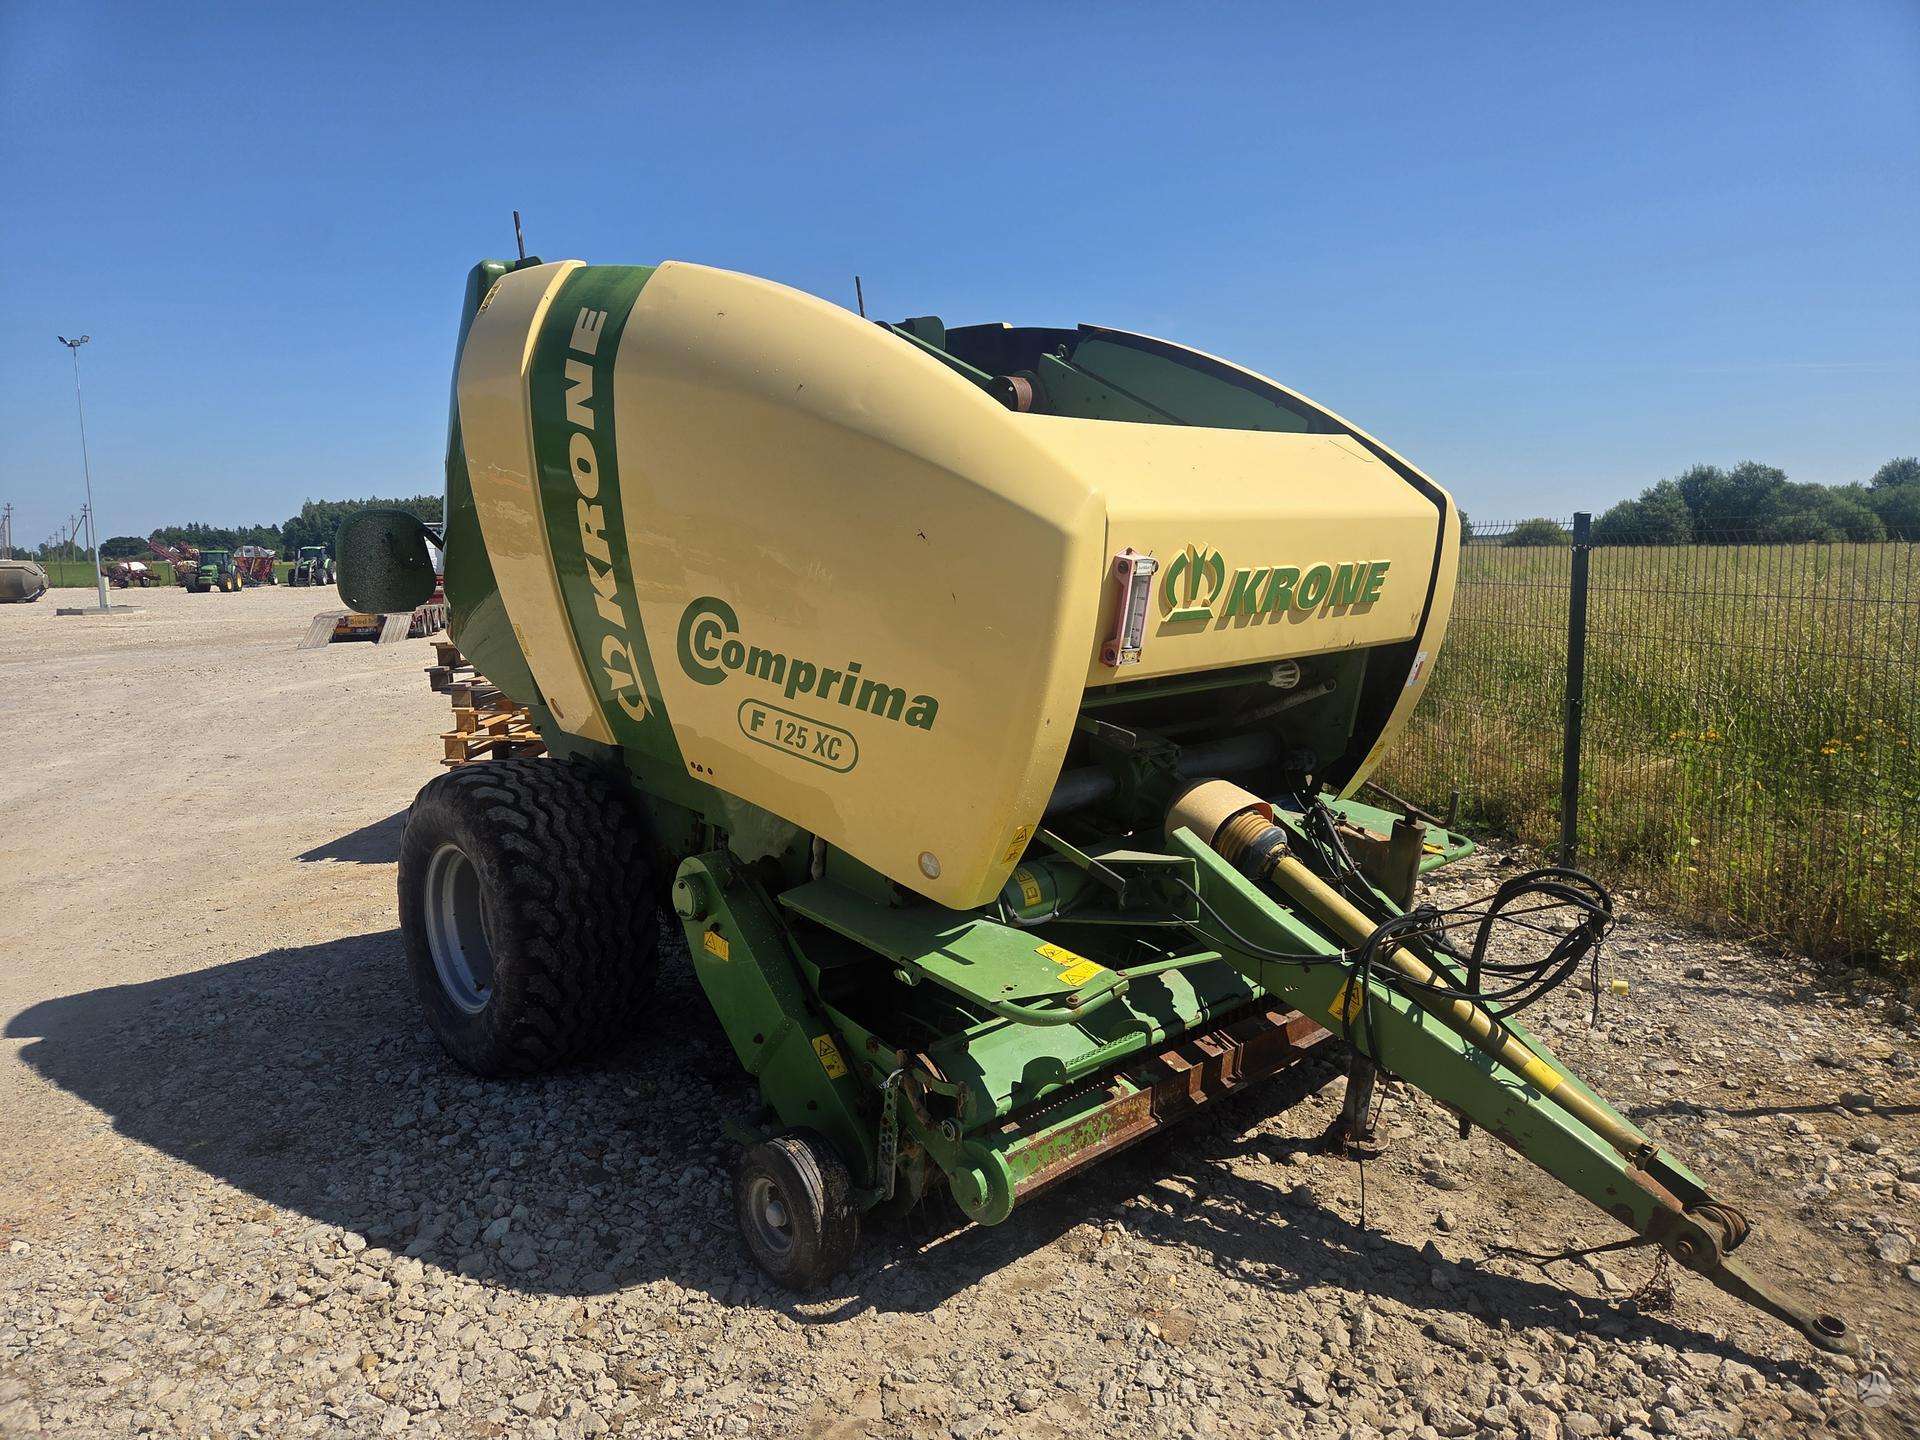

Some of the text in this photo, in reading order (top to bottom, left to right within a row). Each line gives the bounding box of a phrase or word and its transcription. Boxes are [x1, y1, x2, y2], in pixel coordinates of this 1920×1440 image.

[565, 307, 626, 630] KRONE
[1225, 560, 1391, 617] KRONE
[750, 709, 842, 761] F 125 XC
